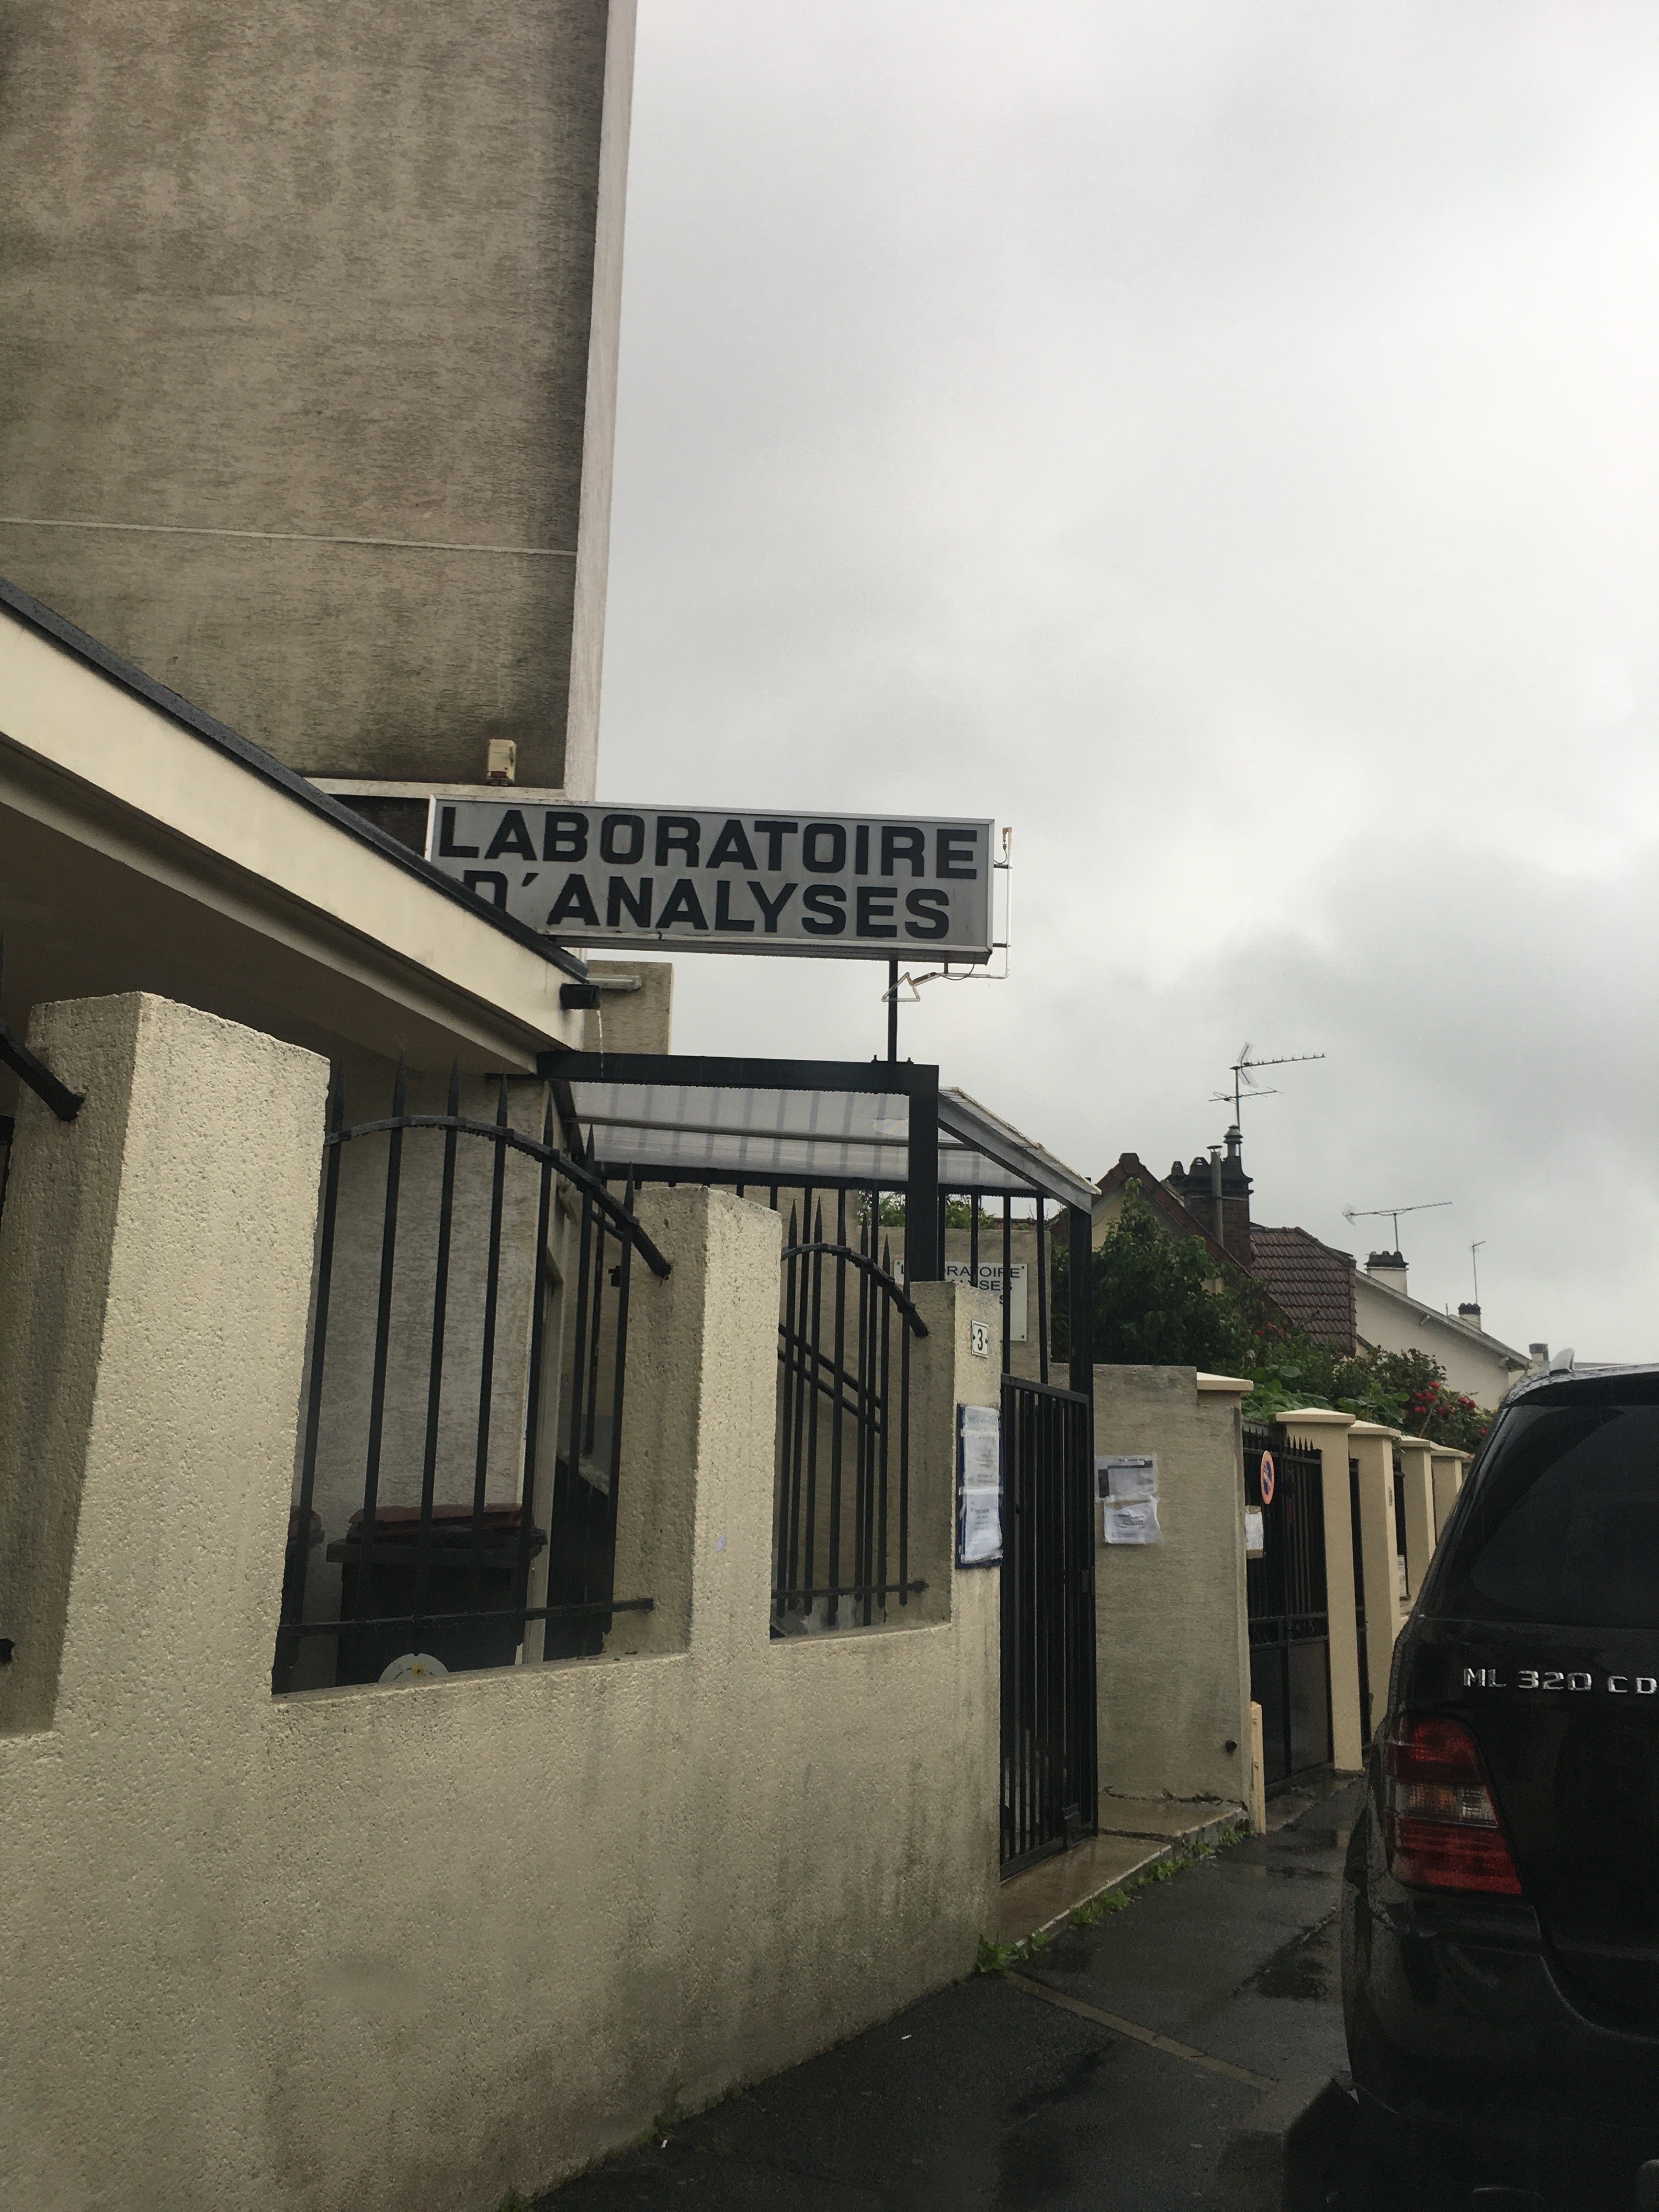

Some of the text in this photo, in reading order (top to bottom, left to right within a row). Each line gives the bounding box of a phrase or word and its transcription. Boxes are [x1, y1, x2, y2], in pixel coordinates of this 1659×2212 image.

[439, 806, 977, 879] LABORATOIRE
[977, 1328, 983, 1351] 3
[1463, 1668, 1506, 1688] ML
[1517, 1671, 1592, 1691] 320
